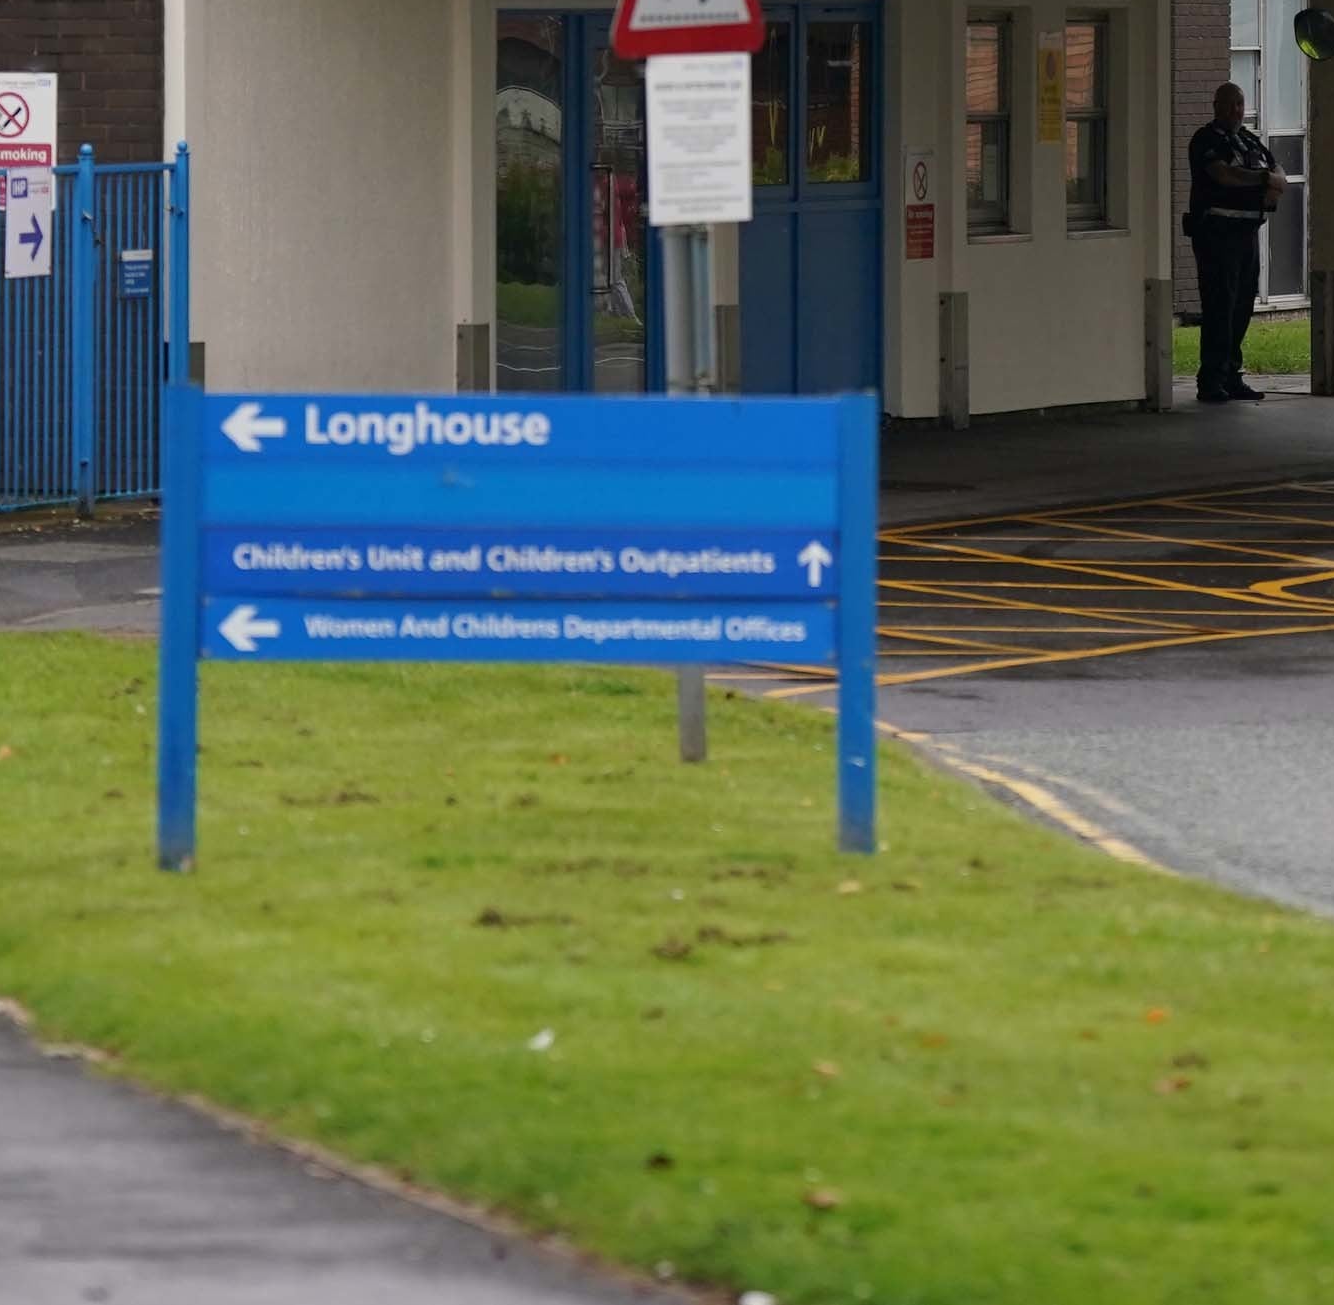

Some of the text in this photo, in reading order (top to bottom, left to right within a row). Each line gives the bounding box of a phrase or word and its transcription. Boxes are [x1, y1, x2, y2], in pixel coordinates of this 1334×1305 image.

[305, 404, 551, 455] Longhouse
[233, 544, 776, 579] Children's Unit and Children's Outpatients
[305, 616, 807, 644] Women And Childrens Departmental Offices
